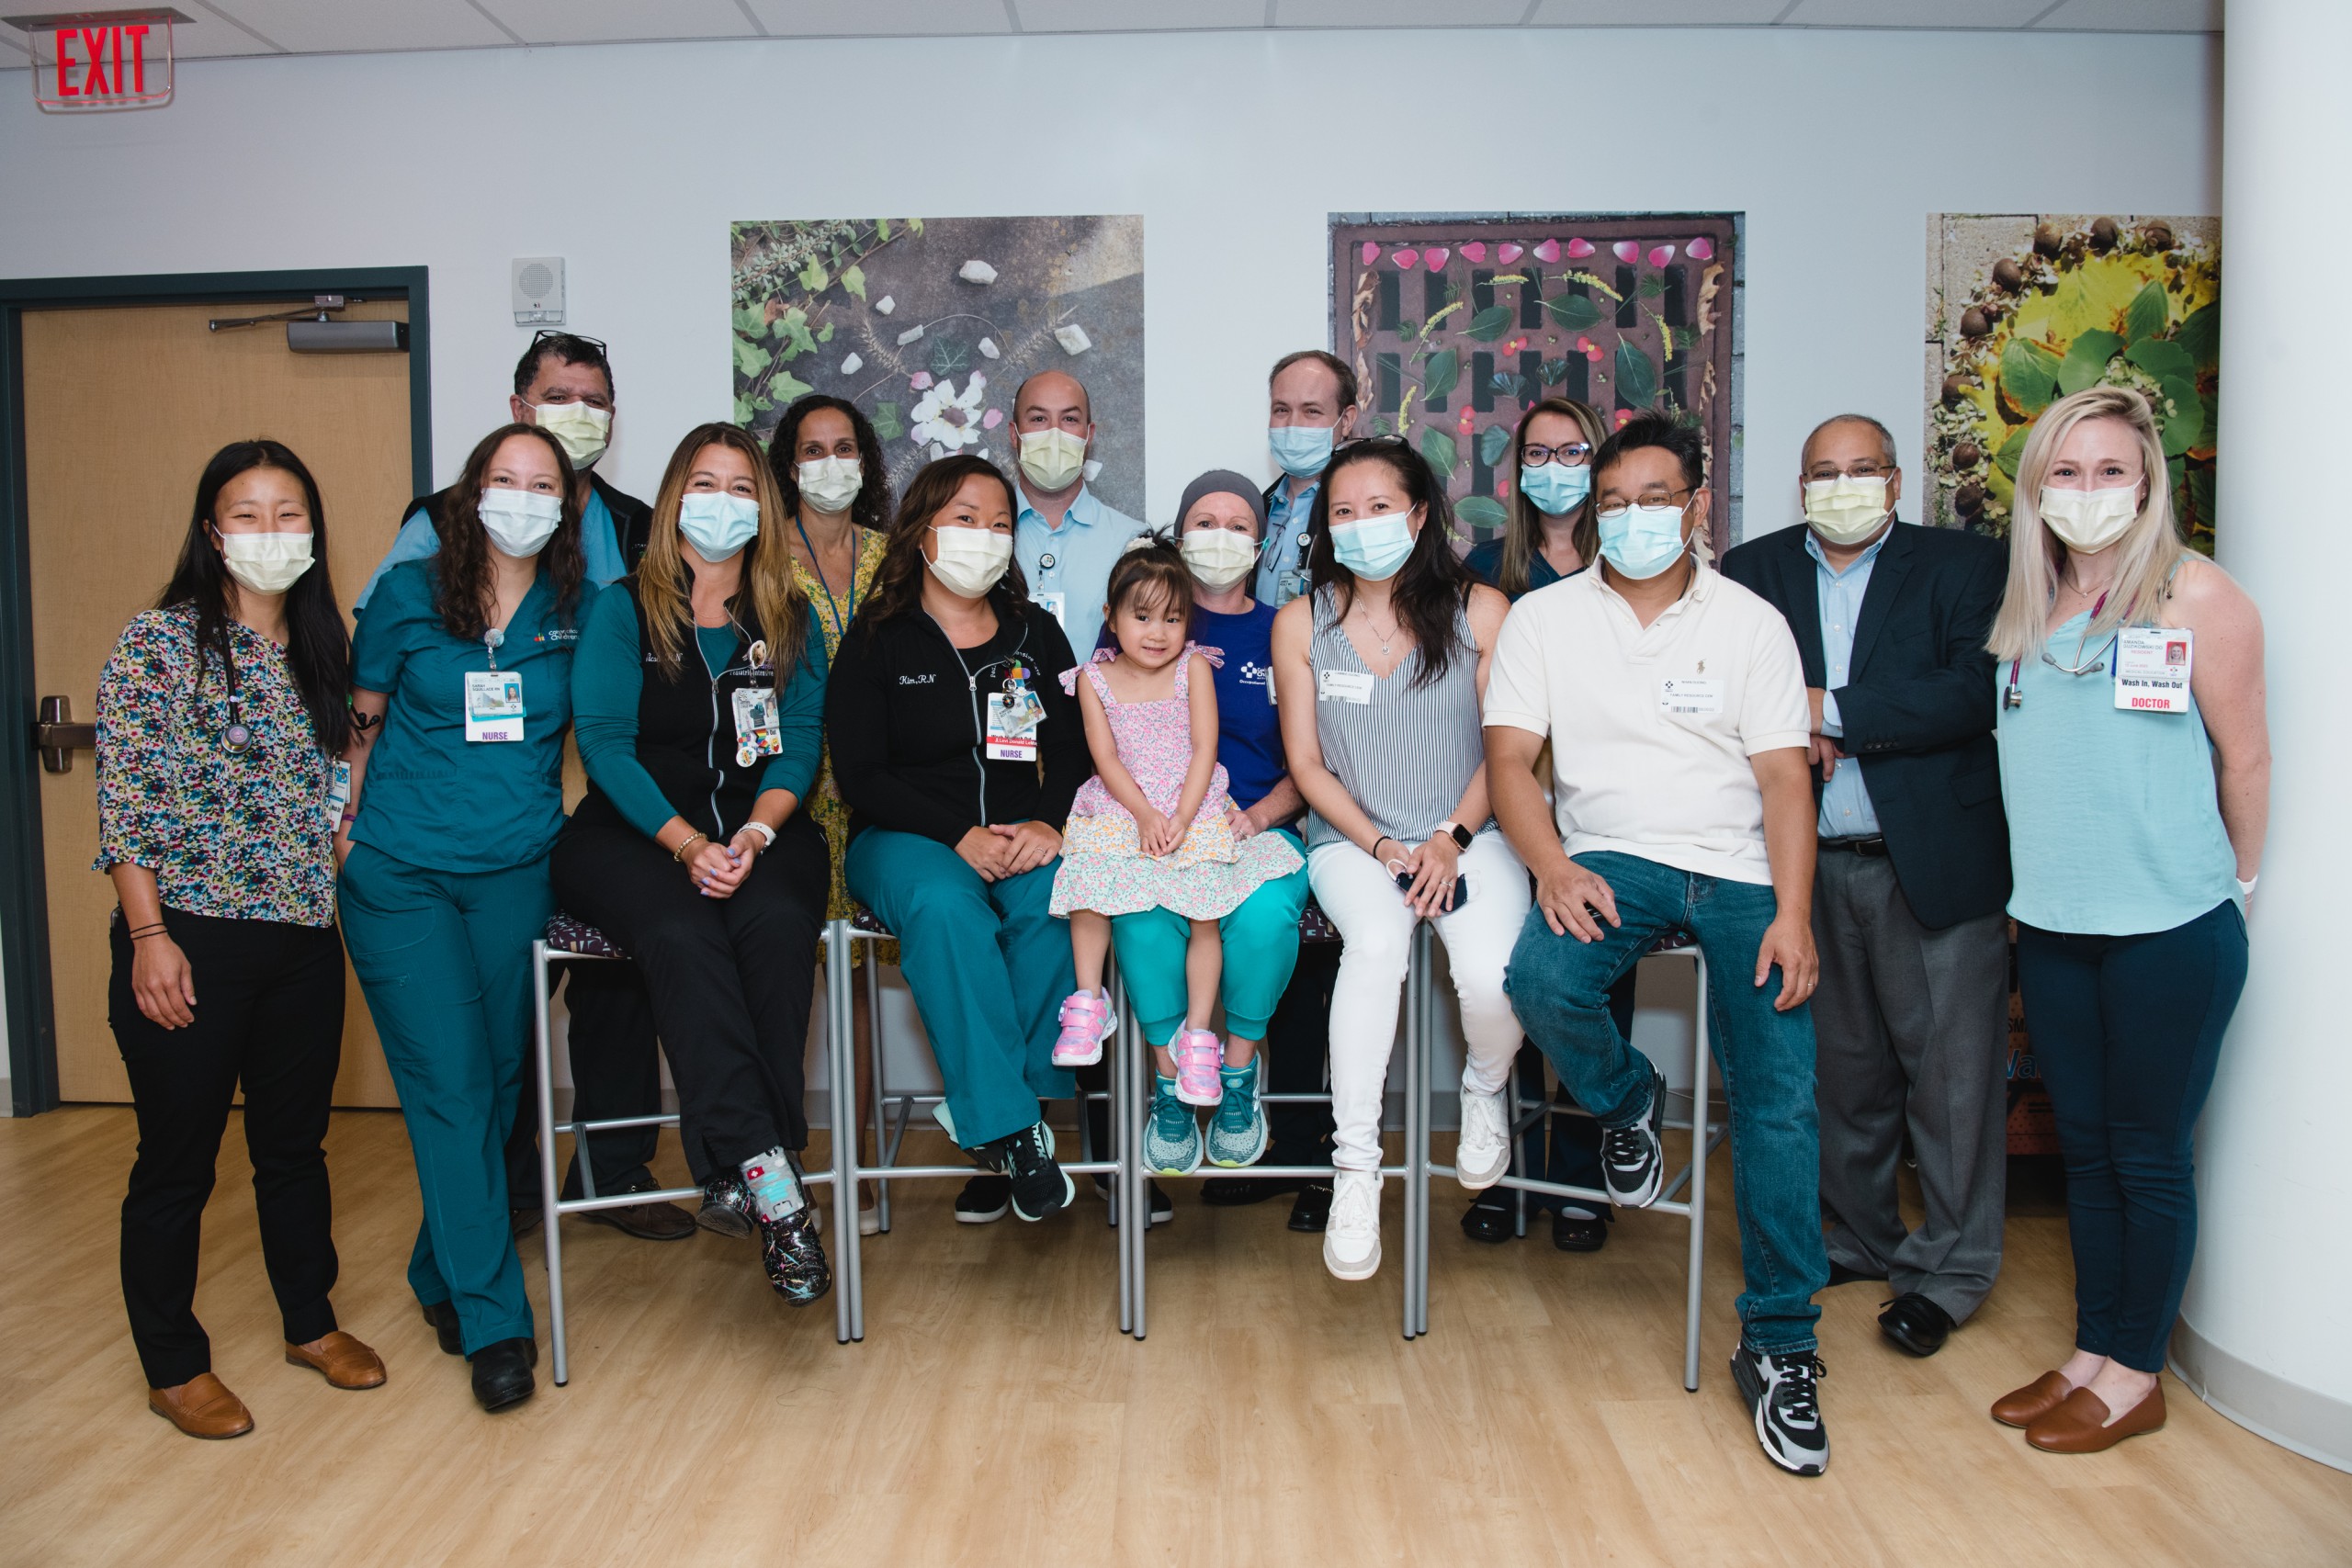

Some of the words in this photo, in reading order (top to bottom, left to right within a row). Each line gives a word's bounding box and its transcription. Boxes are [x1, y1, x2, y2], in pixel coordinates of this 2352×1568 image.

[56, 25, 150, 96] EXIT
[2122, 679, 2140, 687] Wash
[2142, 680, 2150, 688] In,
[2132, 697, 2170, 709] DOCTOR
[482, 731, 508, 740] NURSE
[1000, 749, 1023, 759] NURSE
